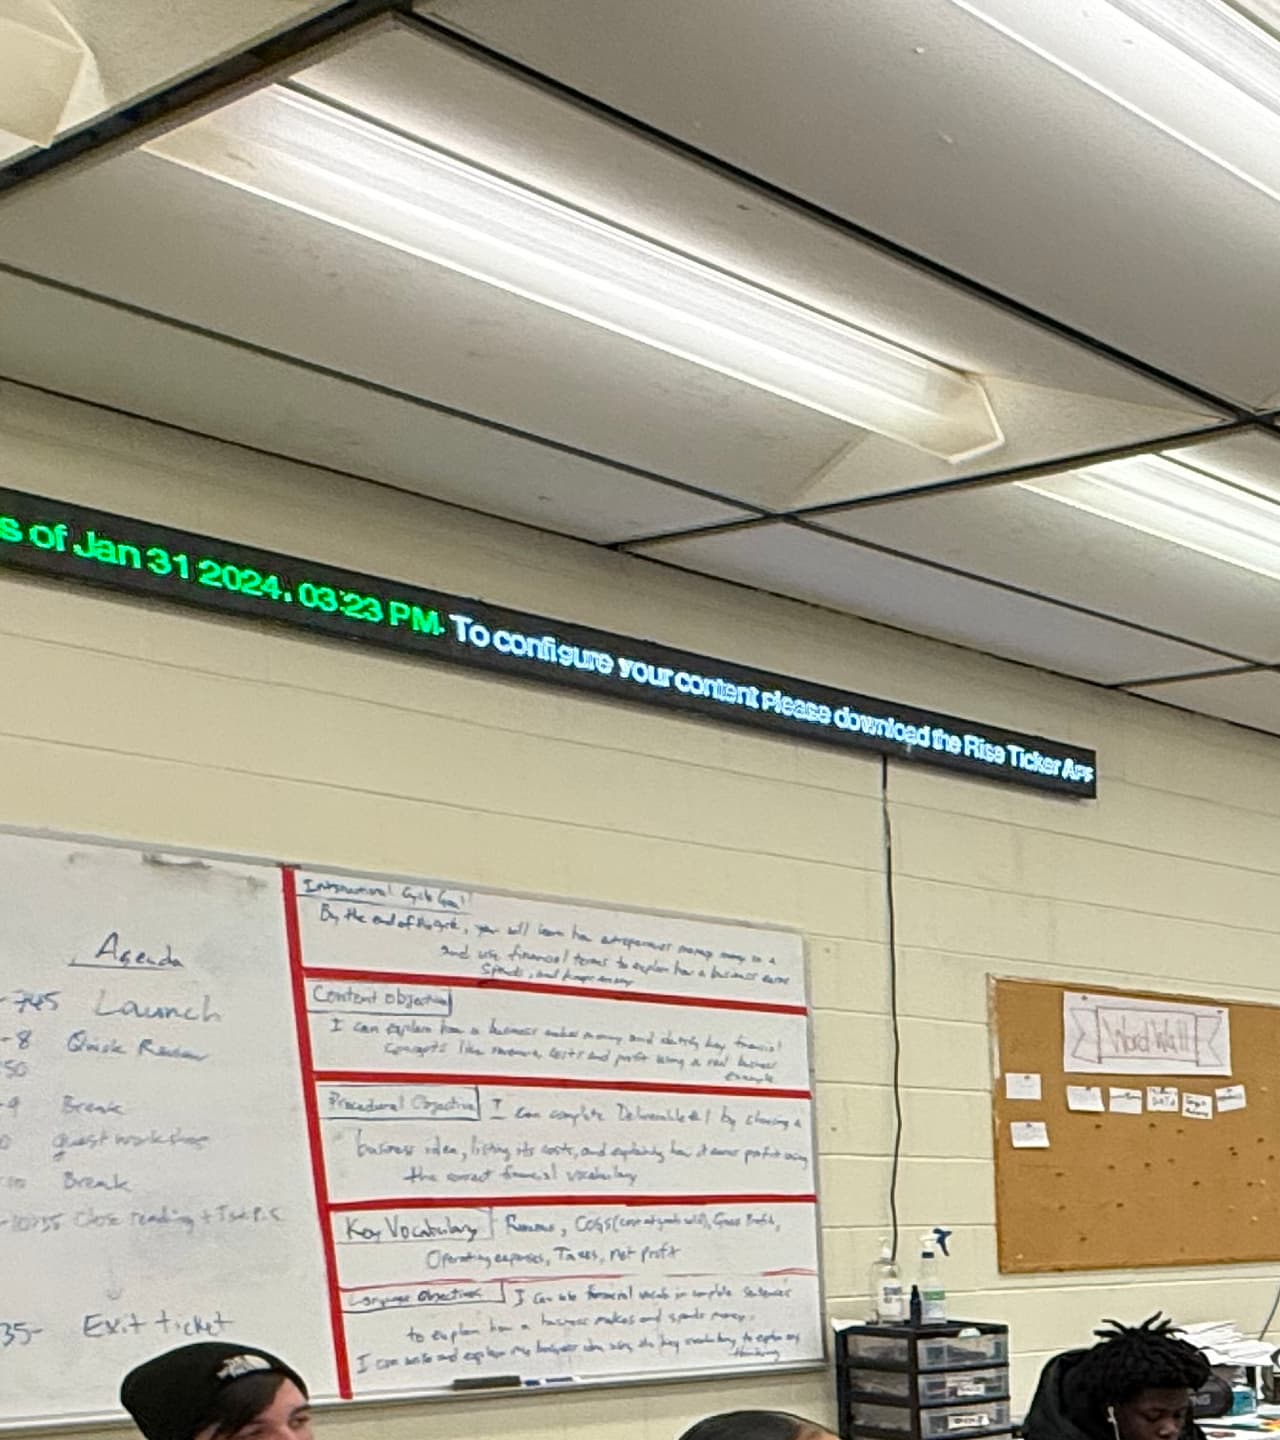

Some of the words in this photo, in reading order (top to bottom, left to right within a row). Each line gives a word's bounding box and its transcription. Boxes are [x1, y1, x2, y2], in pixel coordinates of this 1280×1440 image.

[29, 523, 68, 551] of
[73, 530, 142, 568] Jan
[147, 547, 189, 579] 31
[298, 581, 384, 623] 03:23
[449, 613, 490, 648] To
[493, 629, 615, 675] configure
[617, 657, 674, 688] your
[674, 671, 760, 709] content
[833, 705, 931, 748] download
[931, 727, 962, 756] the
[963, 734, 1005, 766] Rise
[1006, 744, 1063, 777] Ticker
[94, 988, 223, 1022] Launch
[82, 1311, 148, 1338] Exit
[153, 1308, 237, 1338] ticket
